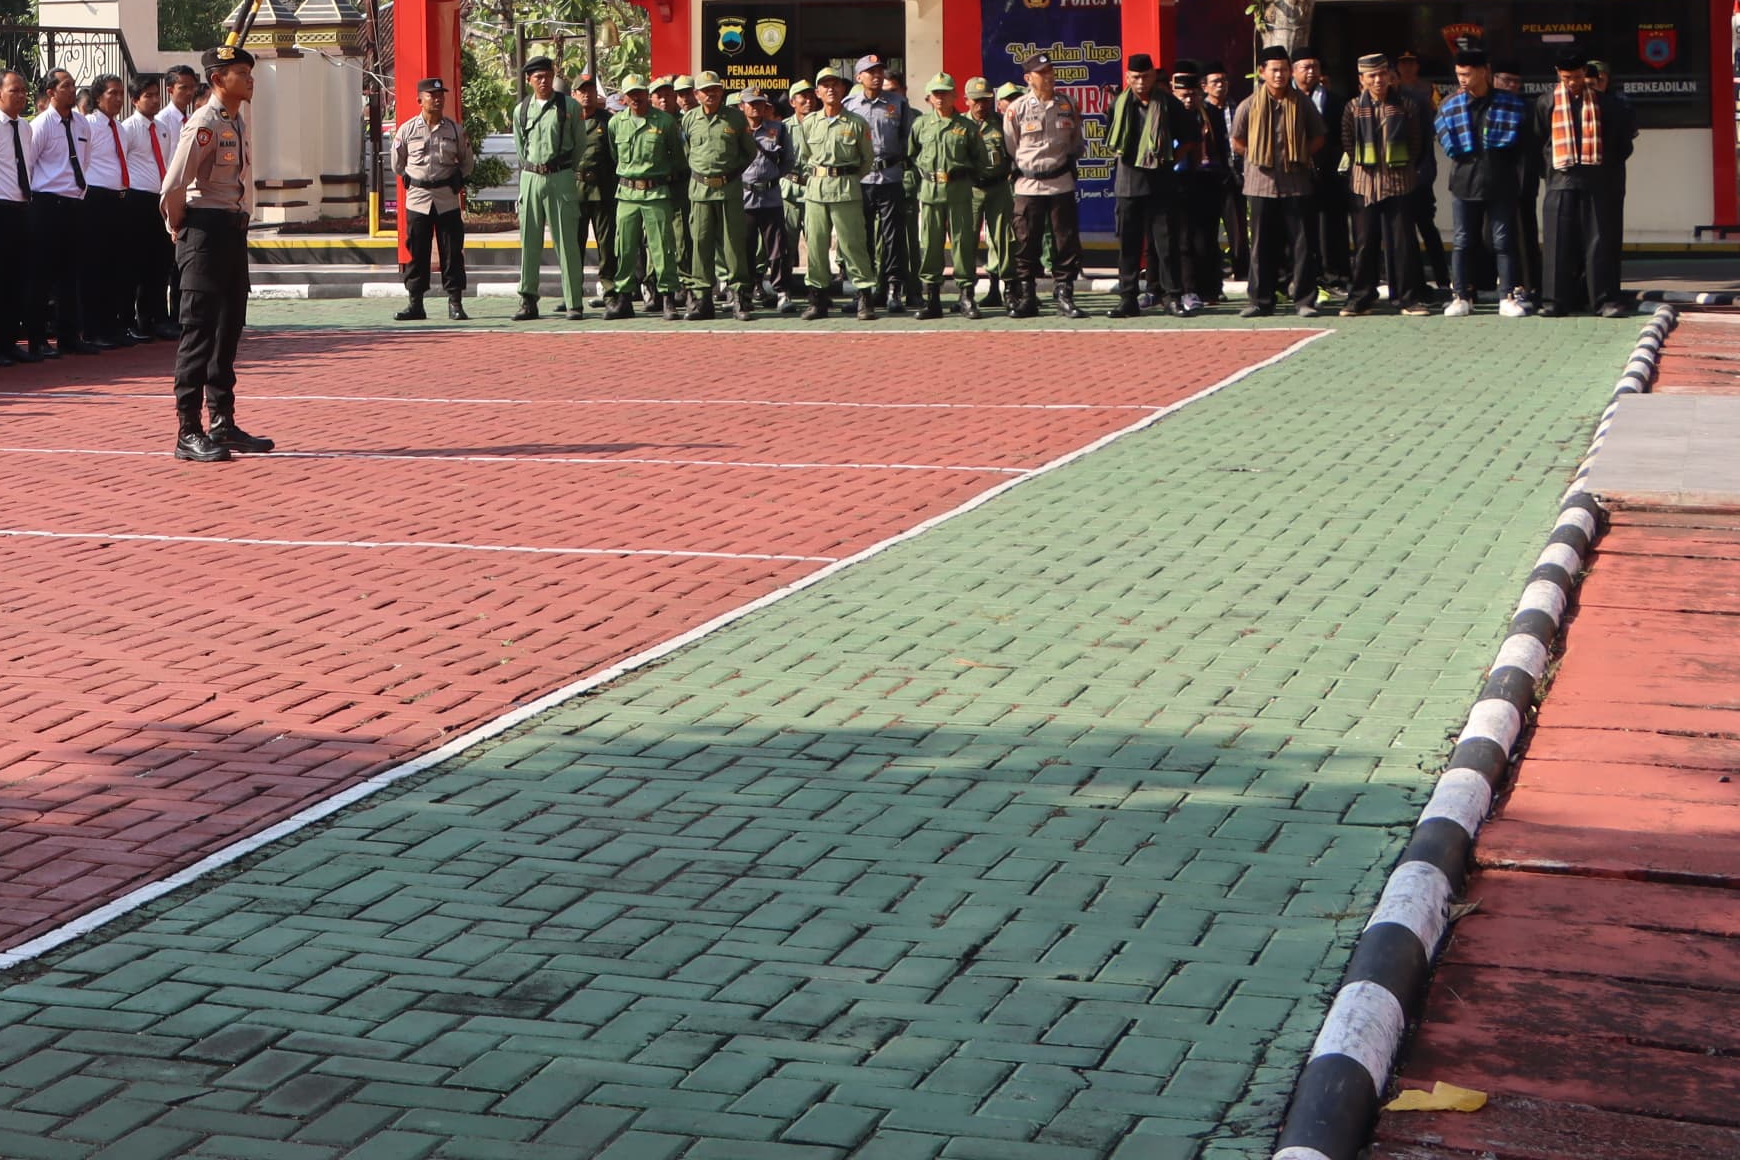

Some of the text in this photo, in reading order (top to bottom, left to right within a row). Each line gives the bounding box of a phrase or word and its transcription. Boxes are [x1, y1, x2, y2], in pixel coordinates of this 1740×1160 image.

[1521, 23, 1593, 33] PELAYANAN
[1082, 42, 1119, 62] Tugas
[727, 64, 778, 76] PENJAGAAN
[1053, 66, 1087, 82] engan
[747, 78, 790, 90] WONOGIRI
[1623, 81, 1697, 93] BERKEADILAN
